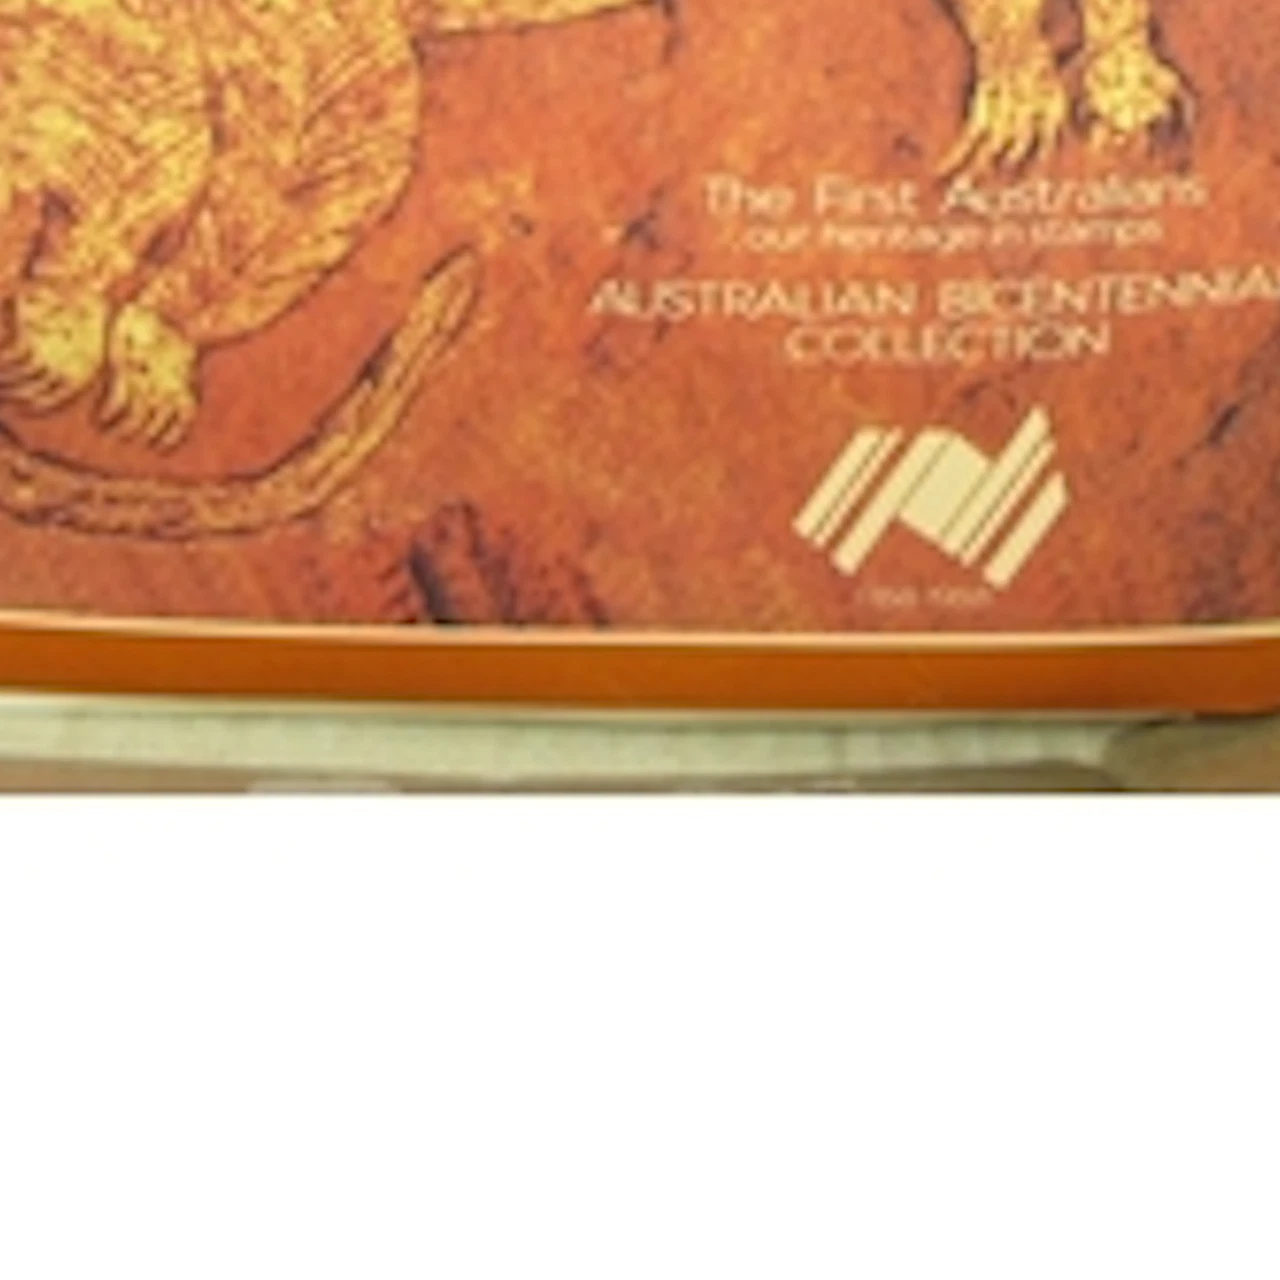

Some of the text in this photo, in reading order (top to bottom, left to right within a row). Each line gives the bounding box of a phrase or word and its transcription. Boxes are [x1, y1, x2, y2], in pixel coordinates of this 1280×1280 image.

[702, 172, 1210, 217] The First Australians
[586, 276, 919, 320] AUSTRALIAN
[783, 322, 1115, 364] COLLECTION
